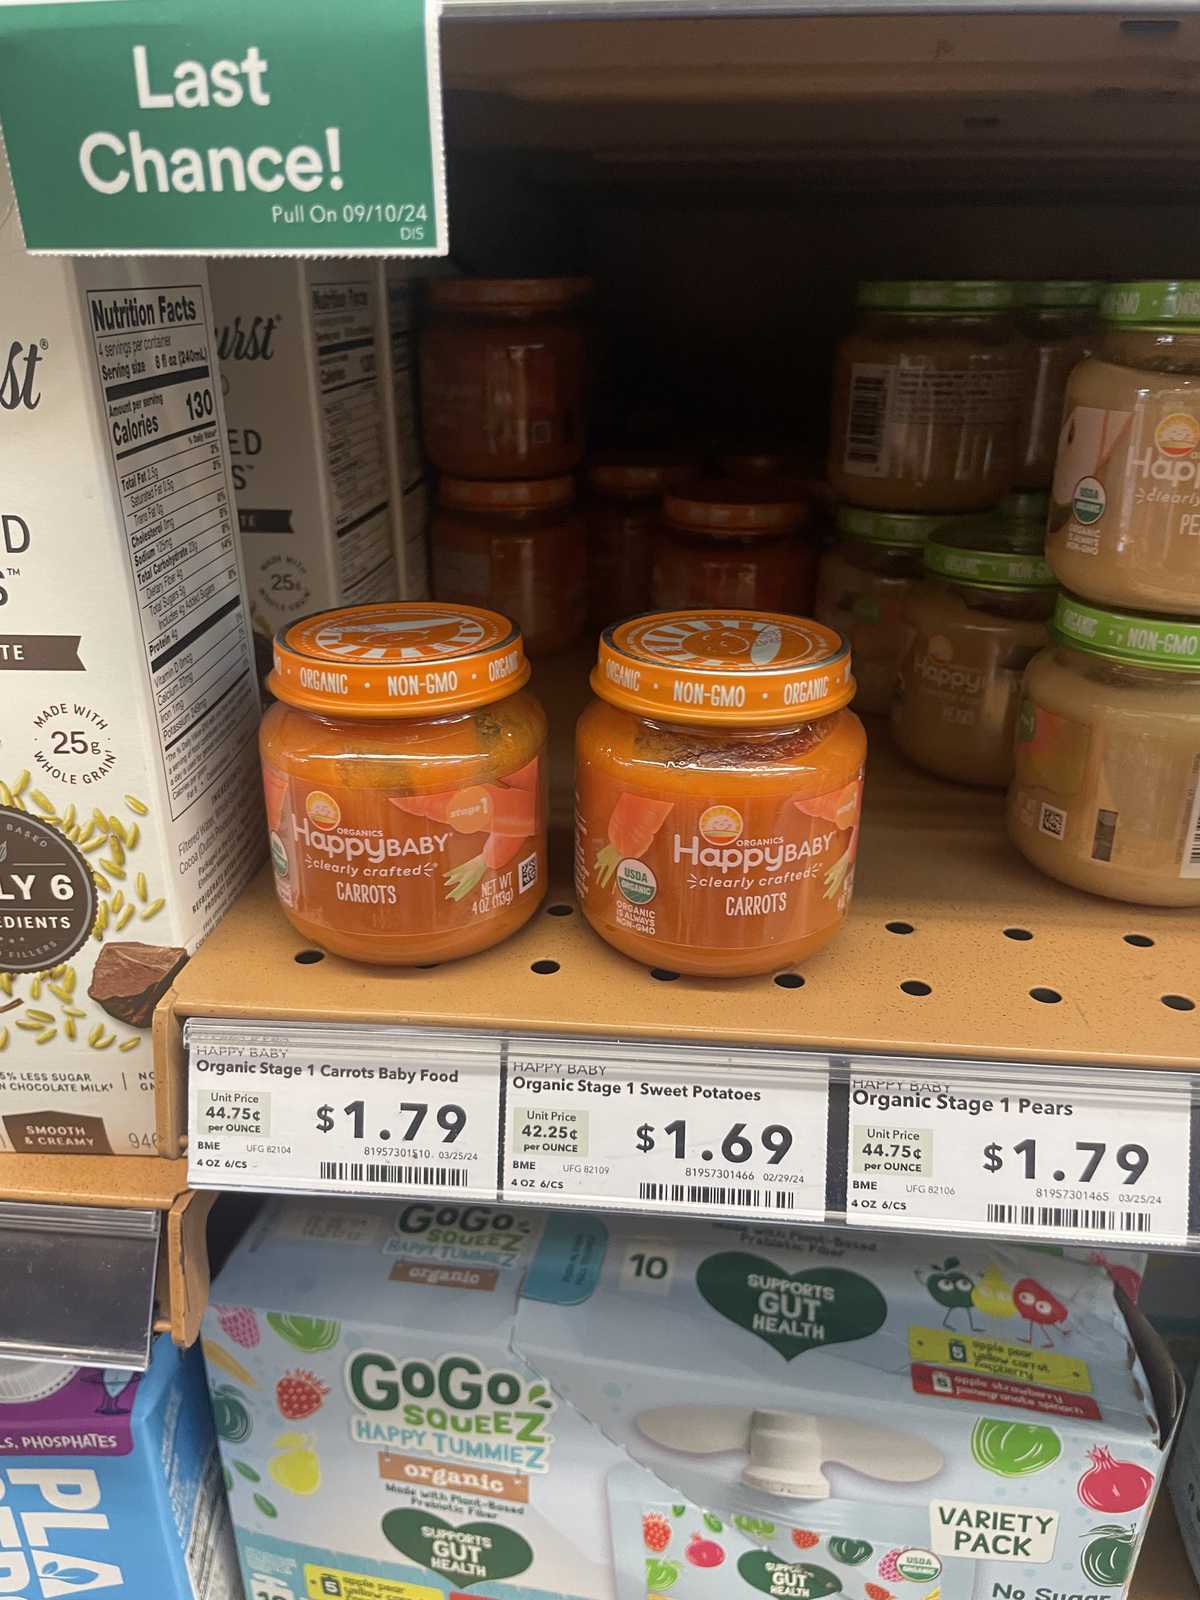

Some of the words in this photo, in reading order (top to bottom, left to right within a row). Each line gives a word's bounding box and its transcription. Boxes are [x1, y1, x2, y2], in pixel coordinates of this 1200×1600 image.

[133, 45, 270, 109] Last
[79, 127, 344, 194] Chance!
[272, 205, 304, 224] Pull
[309, 206, 338, 223] On
[343, 204, 428, 223] 09/10/24
[401, 226, 425, 241] DIS
[92, 297, 156, 331] Nutrition
[158, 295, 197, 323] Facts
[102, 363, 131, 381] Serving
[131, 360, 146, 375] size
[109, 402, 133, 417] Amount
[186, 389, 213, 420] 130
[113, 413, 159, 446] Calories
[131, 524, 163, 549] Cholesterol
[134, 548, 156, 568] Sodium
[153, 546, 188, 575] Carbohydrate
[148, 634, 171, 656] Protein
[1127, 627, 1197, 656] NON-GMO
[300, 668, 349, 695] ORGANIC
[387, 670, 459, 697] NON-GMO
[606, 660, 641, 692] ORGANIC
[673, 679, 746, 708] NON-GMO
[783, 675, 830, 705] ORGANIC
[33, 703, 69, 729] MADE
[73, 703, 109, 730] WITH
[51, 731, 101, 755] 25g
[33, 750, 77, 785] WHOLE
[6, 823, 48, 848] BASED
[336, 826, 384, 837] ORGANICS
[736, 835, 784, 848] ORGANICS
[312, 859, 359, 878] clearly
[363, 863, 422, 878] crafted
[624, 867, 648, 883] USDA
[50, 874, 74, 901] 6
[481, 878, 498, 899] NET
[498, 871, 513, 890] WT
[699, 875, 755, 891] clearly
[758, 869, 811, 887] crafted
[336, 881, 397, 905] CARROTS
[615, 900, 656, 919] ORGANIC
[725, 892, 788, 917] CARROTS
[616, 916, 656, 936] NON-GMO
[624, 911, 656, 928] ALWAYS
[9, 939, 57, 959] FILLERS
[20, 1072, 45, 1082] LESS
[51, 1073, 92, 1082] SUGAR
[197, 1060, 256, 1076] Organic
[260, 1062, 302, 1079] Stage
[307, 1064, 315, 1077] 1
[320, 1064, 375, 1080] Carrots
[379, 1067, 417, 1084] Baby
[420, 1069, 459, 1083] Food
[513, 1061, 562, 1074] HAPPY
[567, 1064, 608, 1076] BABY
[10, 1082, 78, 1093] CHOCOLATE
[211, 1092, 232, 1103] Unit
[234, 1094, 260, 1104] Price
[512, 1076, 574, 1093] Organic
[577, 1079, 622, 1096] Stage
[627, 1082, 635, 1095] 1
[640, 1082, 688, 1098] Sweet
[692, 1086, 762, 1102] Potatoes
[853, 1089, 932, 1110] Organic
[937, 1095, 994, 1116] Stage
[1000, 1098, 1009, 1113] 1
[1018, 1098, 1074, 1116] Pears
[206, 1107, 262, 1122] 44.75¢
[316, 1100, 467, 1143] $1.79
[527, 1111, 549, 1122] Unit
[551, 1112, 577, 1122] Price
[25, 1125, 86, 1136] SMOOTH
[208, 1125, 226, 1134] per
[226, 1123, 262, 1134] OUNCE
[521, 1124, 578, 1141] 42.25¢
[867, 1129, 890, 1140] Unit
[892, 1130, 920, 1142] Price
[24, 1136, 33, 1146] &
[37, 1137, 95, 1147] CREAMY
[197, 1141, 221, 1151] BME
[246, 1144, 265, 1154] UFG
[266, 1145, 292, 1155] 82104
[438, 1151, 479, 1161] 03/25/24
[523, 1144, 541, 1154] per
[542, 1143, 578, 1153] OUNCE
[635, 1119, 793, 1165] $1.69
[862, 1143, 923, 1160] 44.75¢
[196, 1159, 203, 1168] 4
[205, 1159, 221, 1168] OZ
[225, 1160, 248, 1169] 6/CS
[512, 1160, 536, 1171] BME
[562, 1164, 582, 1174] UFG
[583, 1165, 610, 1175] 82109
[685, 1168, 756, 1181] 81957301466
[762, 1173, 804, 1184] 02/29/24
[864, 1162, 882, 1173] per
[883, 1162, 922, 1173] OUNCE
[982, 1138, 1150, 1185] $1.79
[511, 1179, 518, 1188] 4
[520, 1179, 536, 1188] OZ
[540, 1180, 564, 1190] 6/CS
[852, 1180, 878, 1191] BME
[905, 1184, 926, 1194] UFG
[927, 1185, 956, 1196] 82106
[1035, 1187, 1110, 1201] 81957301465
[1118, 1193, 1162, 1205] 03/25/24
[851, 1199, 859, 1208] 4
[860, 1199, 877, 1210] OZ
[881, 1200, 907, 1211] 6/CS
[409, 1266, 481, 1285] organic
[629, 1252, 669, 1280] 10
[747, 1273, 835, 1301] SUPPORTS
[758, 1291, 821, 1322] GUT
[752, 1314, 825, 1341] HEALTH
[350, 1352, 521, 1411] GoGo
[22, 1433, 117, 1449] PHOSPHATES
[357, 1419, 427, 1446] HAPPY
[432, 1432, 546, 1469] TUMMIEZ
[404, 1463, 505, 1494] organic
[386, 1482, 417, 1496] Made
[420, 1489, 449, 1501] with
[451, 1495, 525, 1515] Plant-Based
[939, 1506, 1054, 1535] VARIETY
[420, 1525, 493, 1548] SUPPORTS
[954, 1530, 1033, 1556] PACK
[432, 1540, 483, 1564] GUT
[431, 1556, 487, 1578] HEALTH
[772, 1572, 807, 1587] GUT
[770, 1586, 811, 1598] HEALTH
[992, 1582, 1025, 1600] No
